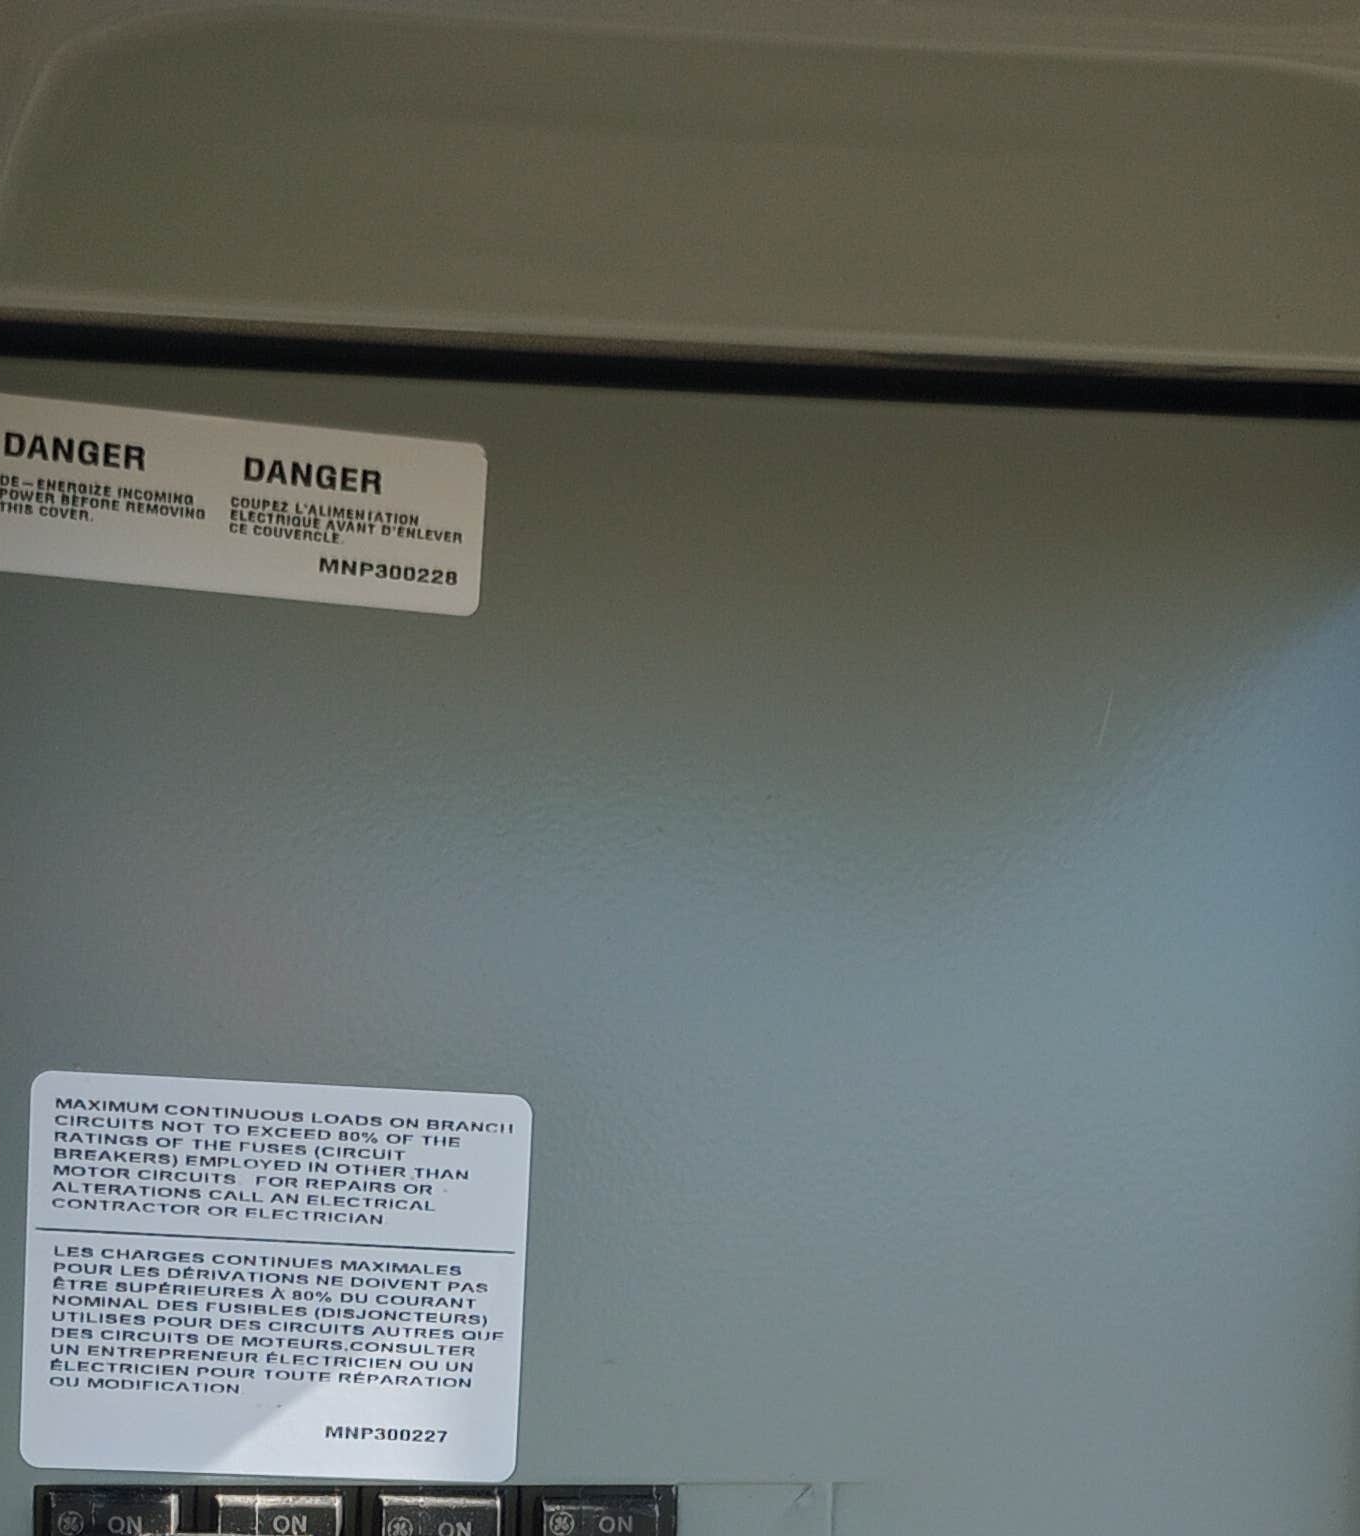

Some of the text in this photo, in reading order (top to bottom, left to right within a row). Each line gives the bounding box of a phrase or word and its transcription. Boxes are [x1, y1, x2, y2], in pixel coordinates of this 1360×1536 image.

[5, 432, 144, 470] DANGER
[244, 457, 380, 494] DANGER
[0, 488, 204, 519] POWER BEFORE REMOVING
[117, 487, 193, 505] INCOMING
[0, 501, 92, 521] THIS COVER.
[230, 497, 418, 525] COUPEZ L'ALIMENTATION
[229, 522, 247, 534] CE
[325, 519, 374, 534] AVANT
[381, 524, 461, 543] D'ENLEVER
[319, 557, 457, 585] MNP300228
[56, 1098, 512, 1133] MAXIMUM CONTINUOUS LOADS ON BRANCH
[55, 1115, 459, 1147] CIRCUITS NOT TO EXCEED 80% OF THE
[55, 1131, 404, 1160] RATINGS OF THE FUSES (CIRCUIT
[54, 1147, 467, 1179] BREAKERS) EMPLOYED IN OTHER THAN
[53, 1164, 129, 1179] MOTOR
[256, 1176, 297, 1187] FOR
[306, 1178, 395, 1193] REPAIRS
[403, 1184, 431, 1194] OR
[52, 1181, 434, 1211] ALTERATIONS CALL AN ELECTRICAL
[52, 1198, 199, 1215] CONTRACTOR
[208, 1206, 237, 1216] OR
[54, 1245, 461, 1275] LES CHARGES CONTINUES MAXIMALES
[54, 1262, 487, 1292] POUR LES DÉRIVATIONS NE DOIVENT PAS
[53, 1276, 475, 1308] ÊTRE SUPÉRIEURES À 80% DU COURANT
[52, 1295, 486, 1327] NOMINAL DES FUSIBLES (DISJONCTEURS)
[51, 1327, 92, 1338] DES
[100, 1330, 198, 1344] CIRCUITS
[206, 1334, 233, 1345] DE
[154, 1316, 211, 1328] POUR
[220, 1318, 260, 1330] DES
[268, 1321, 363, 1335] CIRCUITS
[371, 1326, 454, 1339] AUTRES
[462, 1330, 503, 1340] QUE
[51, 1343, 472, 1372] UN ENTREPRENEUR ÉLECTRICIEN OU UN
[49, 1376, 78, 1386] OU
[50, 1358, 471, 1387] ÉLECTRICIEN POUR TOUTE RÉPARATION
[325, 1426, 447, 1442] MNP300227
[108, 1516, 141, 1533] ON
[272, 1515, 307, 1533] ON
[599, 1516, 633, 1533] ON
